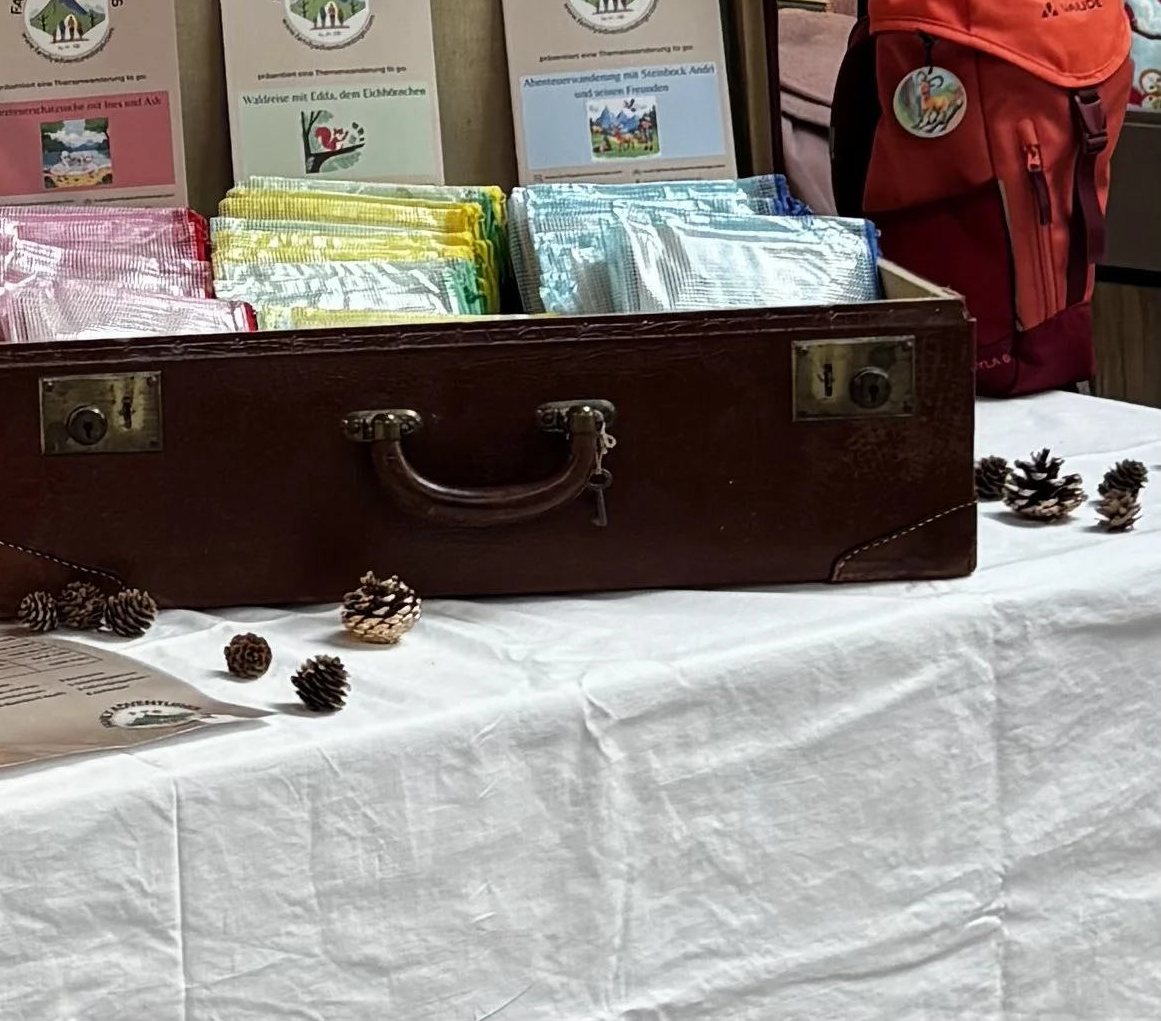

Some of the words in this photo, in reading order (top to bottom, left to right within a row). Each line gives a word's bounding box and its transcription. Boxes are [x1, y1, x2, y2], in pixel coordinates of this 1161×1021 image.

[623, 70, 639, 80] mit
[641, 65, 687, 79] Steinbock
[243, 93, 290, 105] Waldreise
[292, 92, 308, 103] mit
[339, 89, 361, 100] dem
[363, 86, 427, 99] Eichhörnchen
[574, 89, 593, 100] und
[594, 86, 625, 99] seinen
[627, 83, 670, 96] Freunden
[124, 97, 142, 108] und
